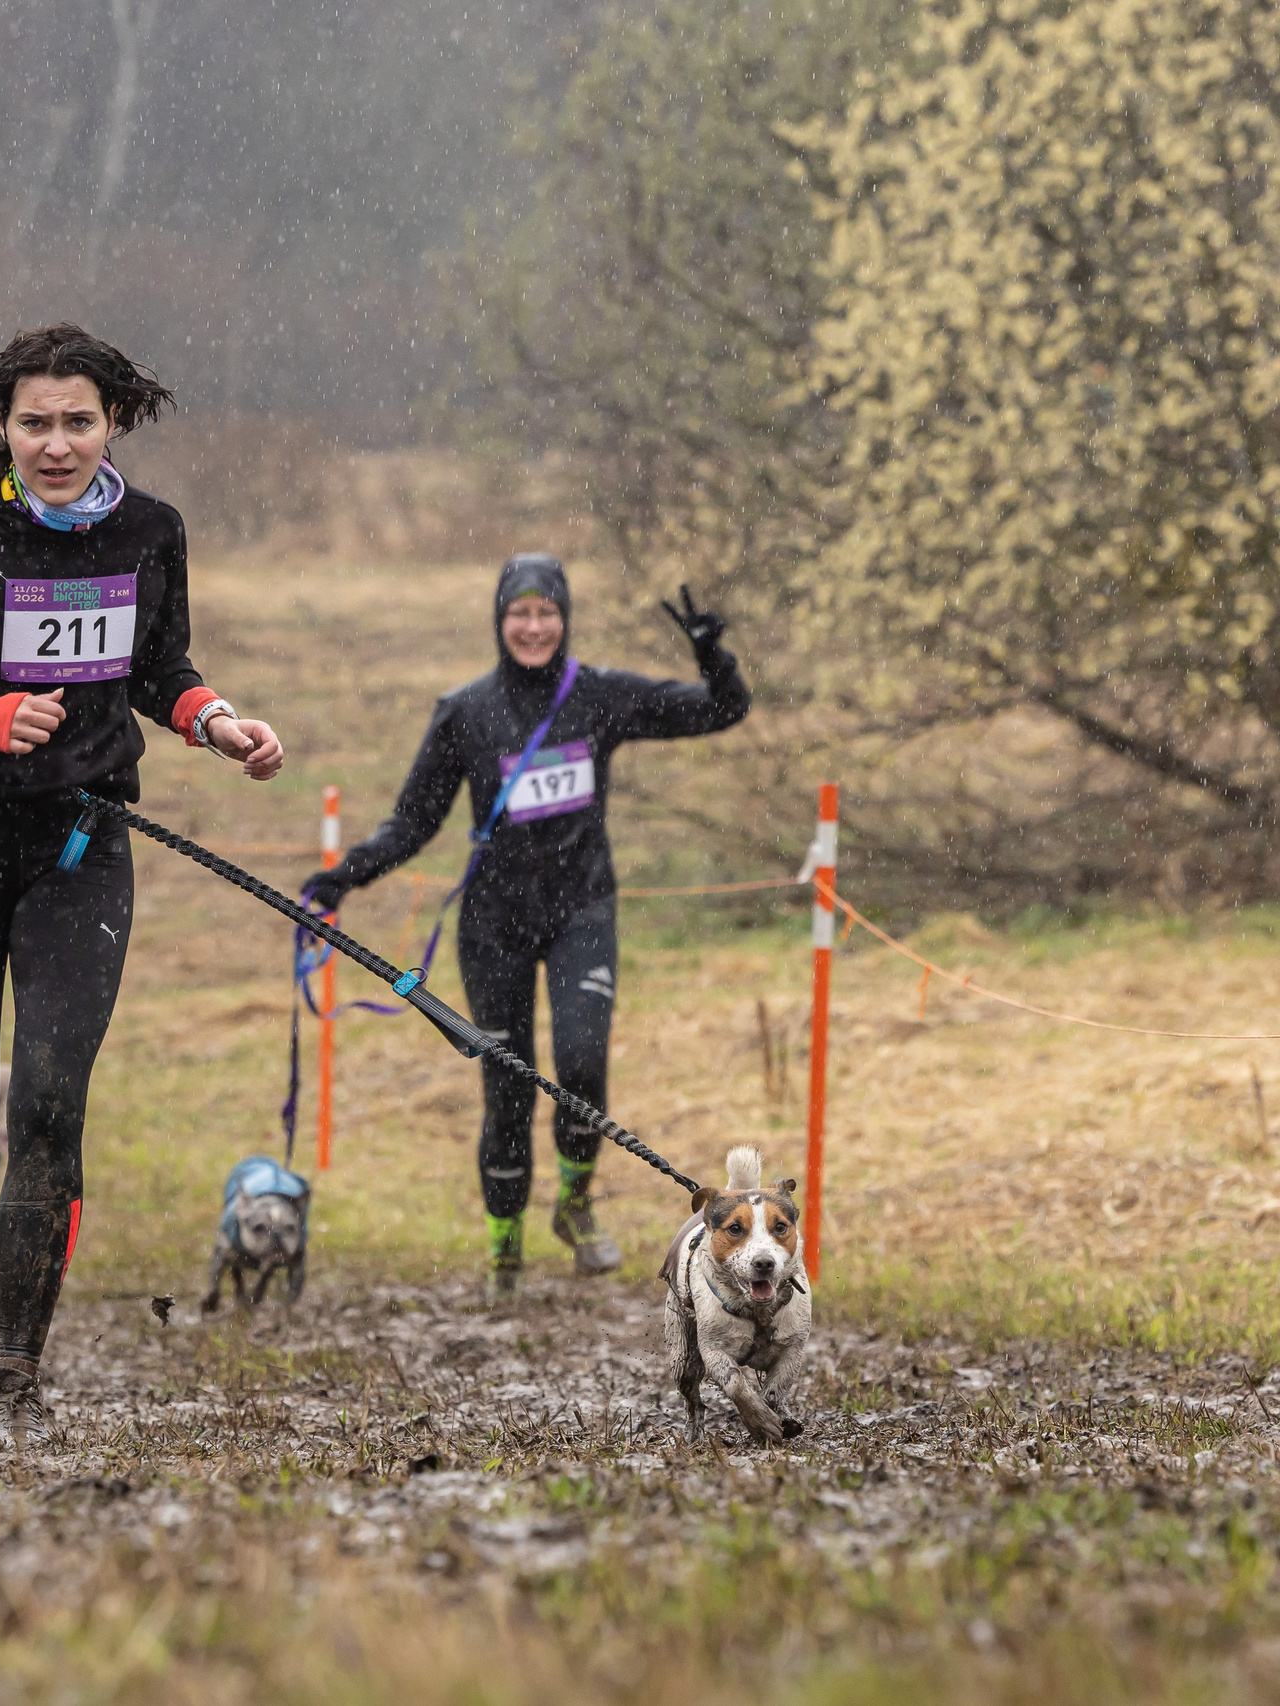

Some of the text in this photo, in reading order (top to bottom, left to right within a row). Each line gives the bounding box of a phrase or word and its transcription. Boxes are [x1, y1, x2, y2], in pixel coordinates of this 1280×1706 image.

[54, 580, 92, 591] КРОСС
[14, 594, 45, 602] 2026
[53, 587, 101, 602] БЫСТРЫЙ
[109, 589, 116, 598] 2
[37, 616, 106, 656] 211
[532, 770, 575, 799] 197
